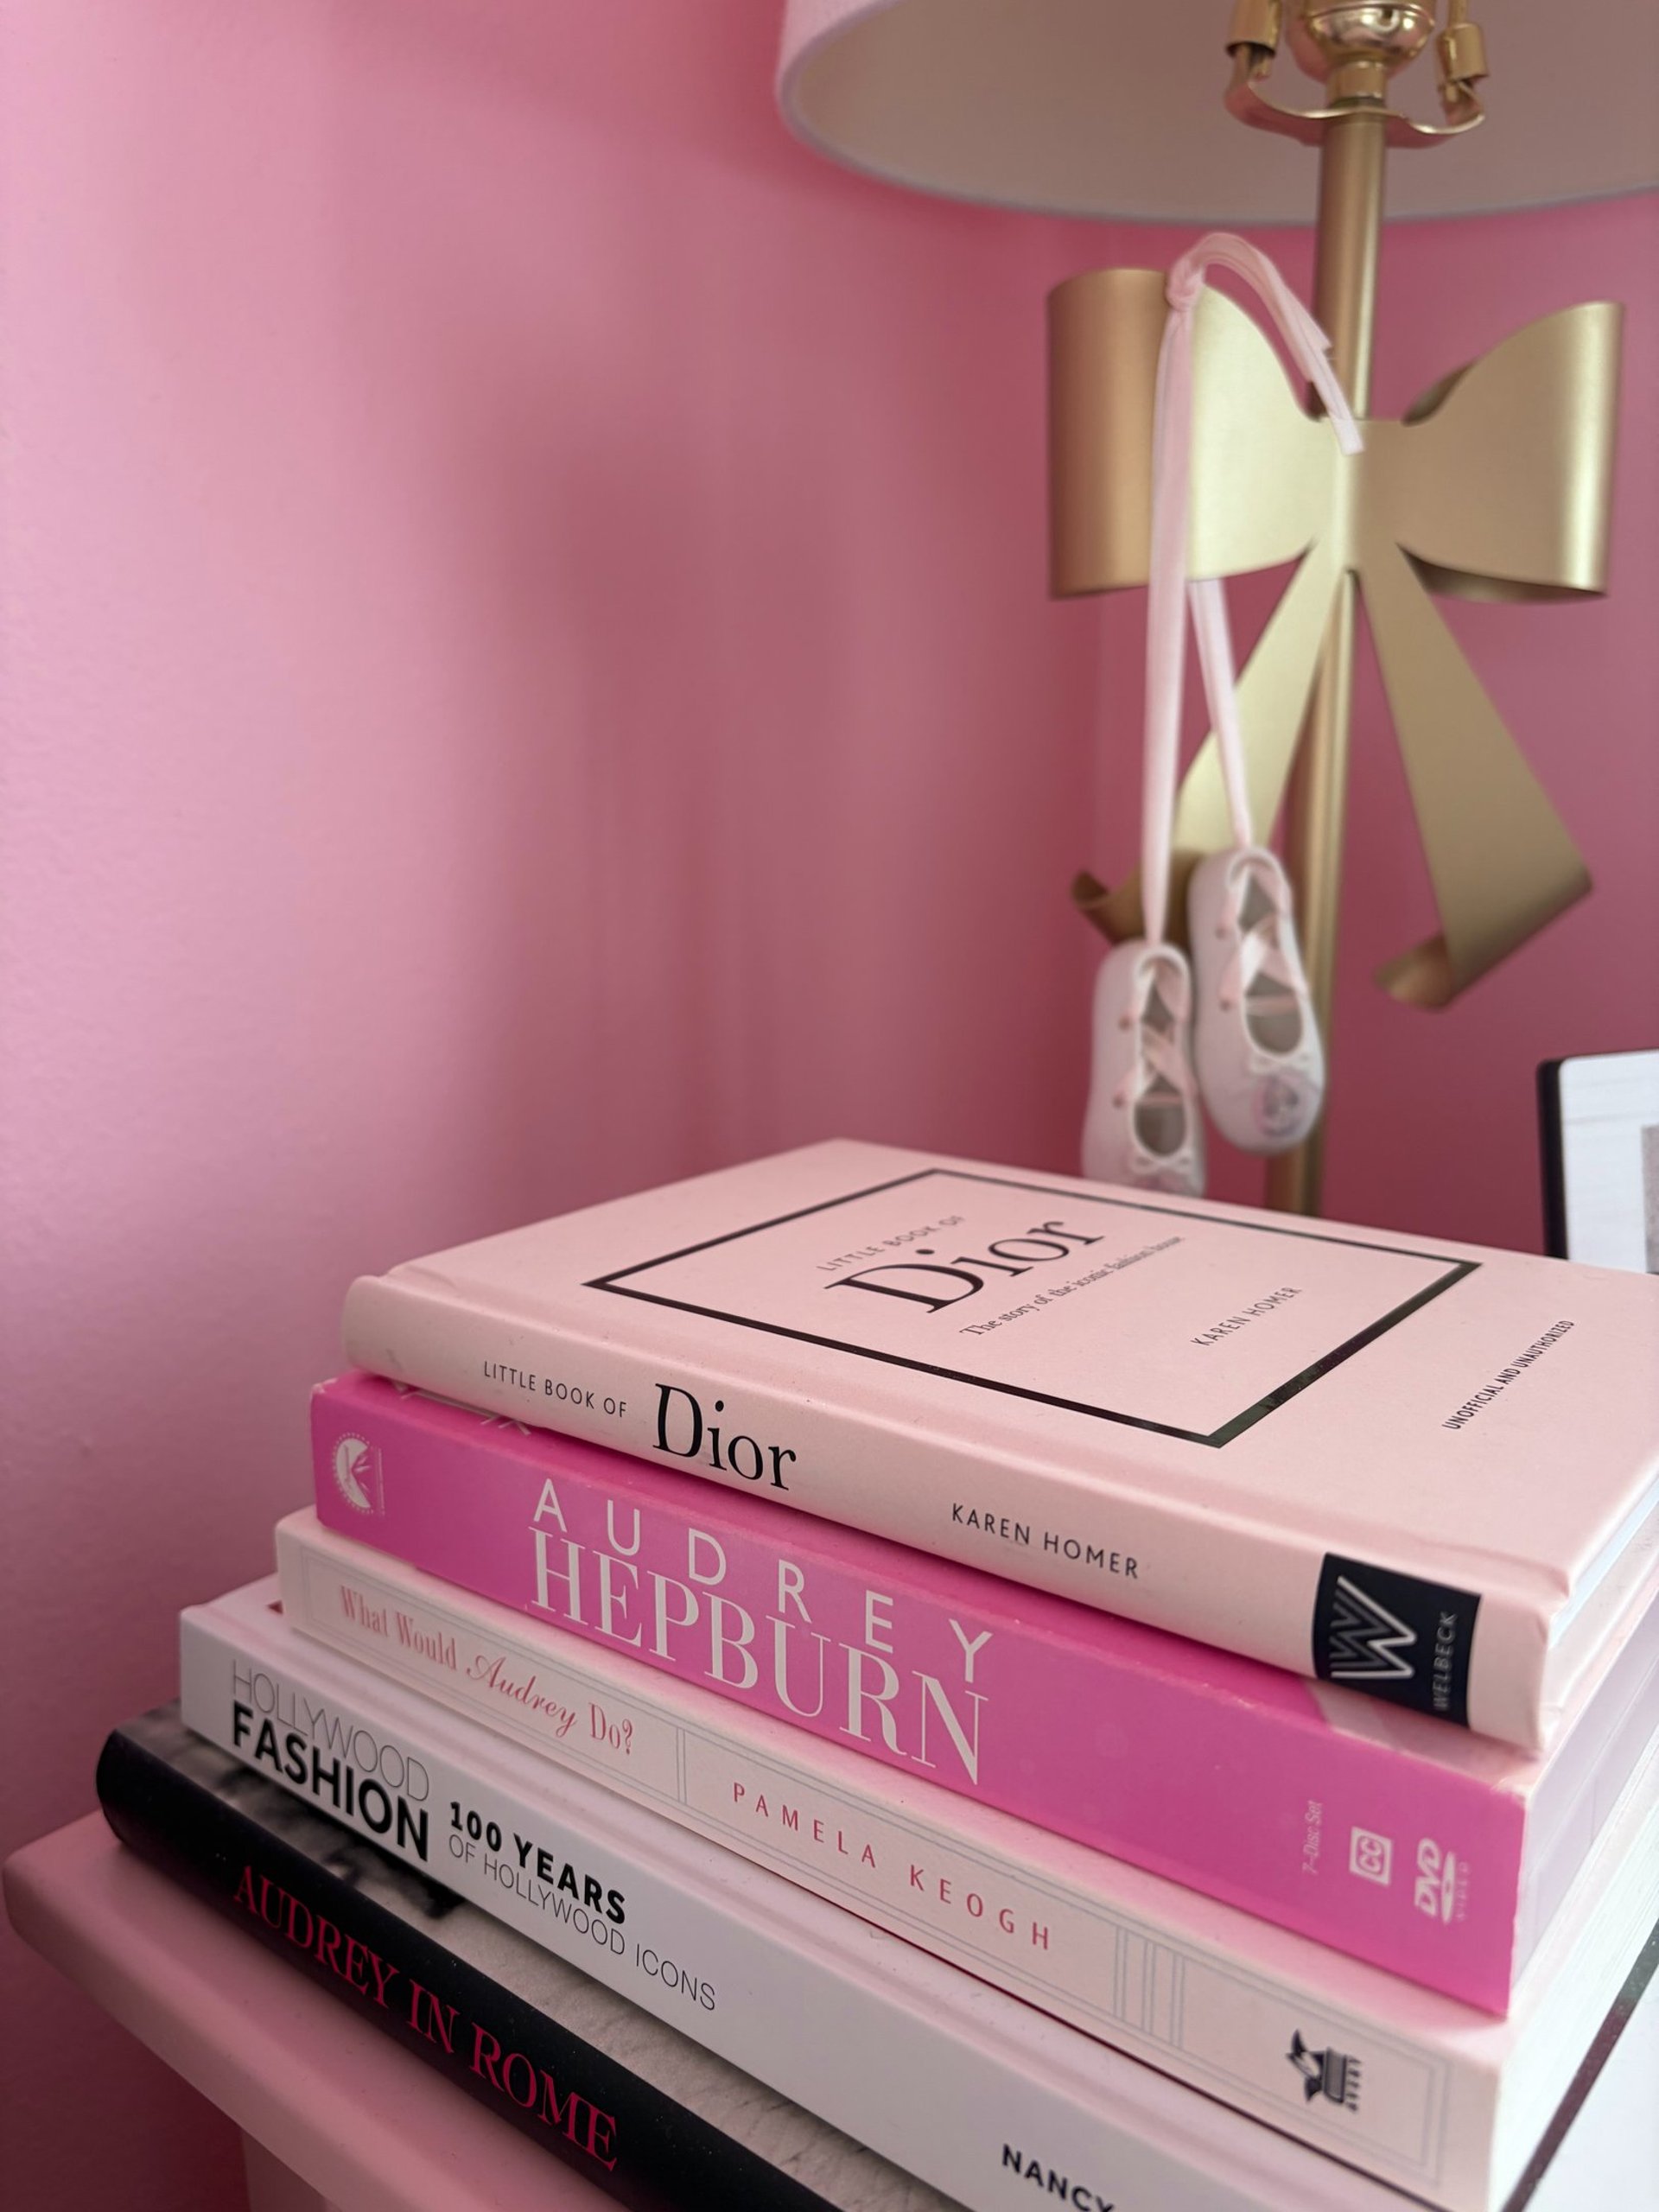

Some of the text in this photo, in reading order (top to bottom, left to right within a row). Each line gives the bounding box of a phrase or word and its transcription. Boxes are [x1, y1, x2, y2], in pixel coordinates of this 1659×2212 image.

[817, 1245, 885, 1271] LITTLE
[882, 1226, 941, 1246] BOOK
[823, 1220, 1104, 1314] Dior
[959, 1319, 1002, 1336] The
[998, 1303, 1040, 1322] story
[1034, 1294, 1053, 1306] of
[1048, 1285, 1077, 1297] the
[1069, 1268, 1114, 1287] iconic
[1190, 1287, 1303, 1345] KAREN HOMER
[484, 1360, 537, 1391] LITTLE
[545, 1380, 594, 1410] BOOK
[603, 1397, 627, 1418] OF
[1441, 1320, 1574, 1430] UNOFFICIAL AND UNAUTHORIZED
[652, 1383, 798, 1491] Dior
[533, 1478, 993, 1683] AUDREY
[951, 1503, 1140, 1580] KAREN HOMER
[340, 1585, 633, 1755] What Would Audrey Do?
[528, 1526, 988, 1785] HEPBURN
[1433, 1611, 1458, 1710] WELBECK
[233, 1659, 429, 1802] HOLLYWOOD
[233, 1700, 429, 1862] FASHION
[450, 1802, 626, 1924] 100 YEARS
[733, 1783, 1051, 1950] PAMELA KEOGH
[1414, 1837, 1441, 1917] DVD
[449, 1834, 715, 2011] OF HOLLYWOOD ICONS
[234, 1865, 618, 2171] AUDREY IN ROME
